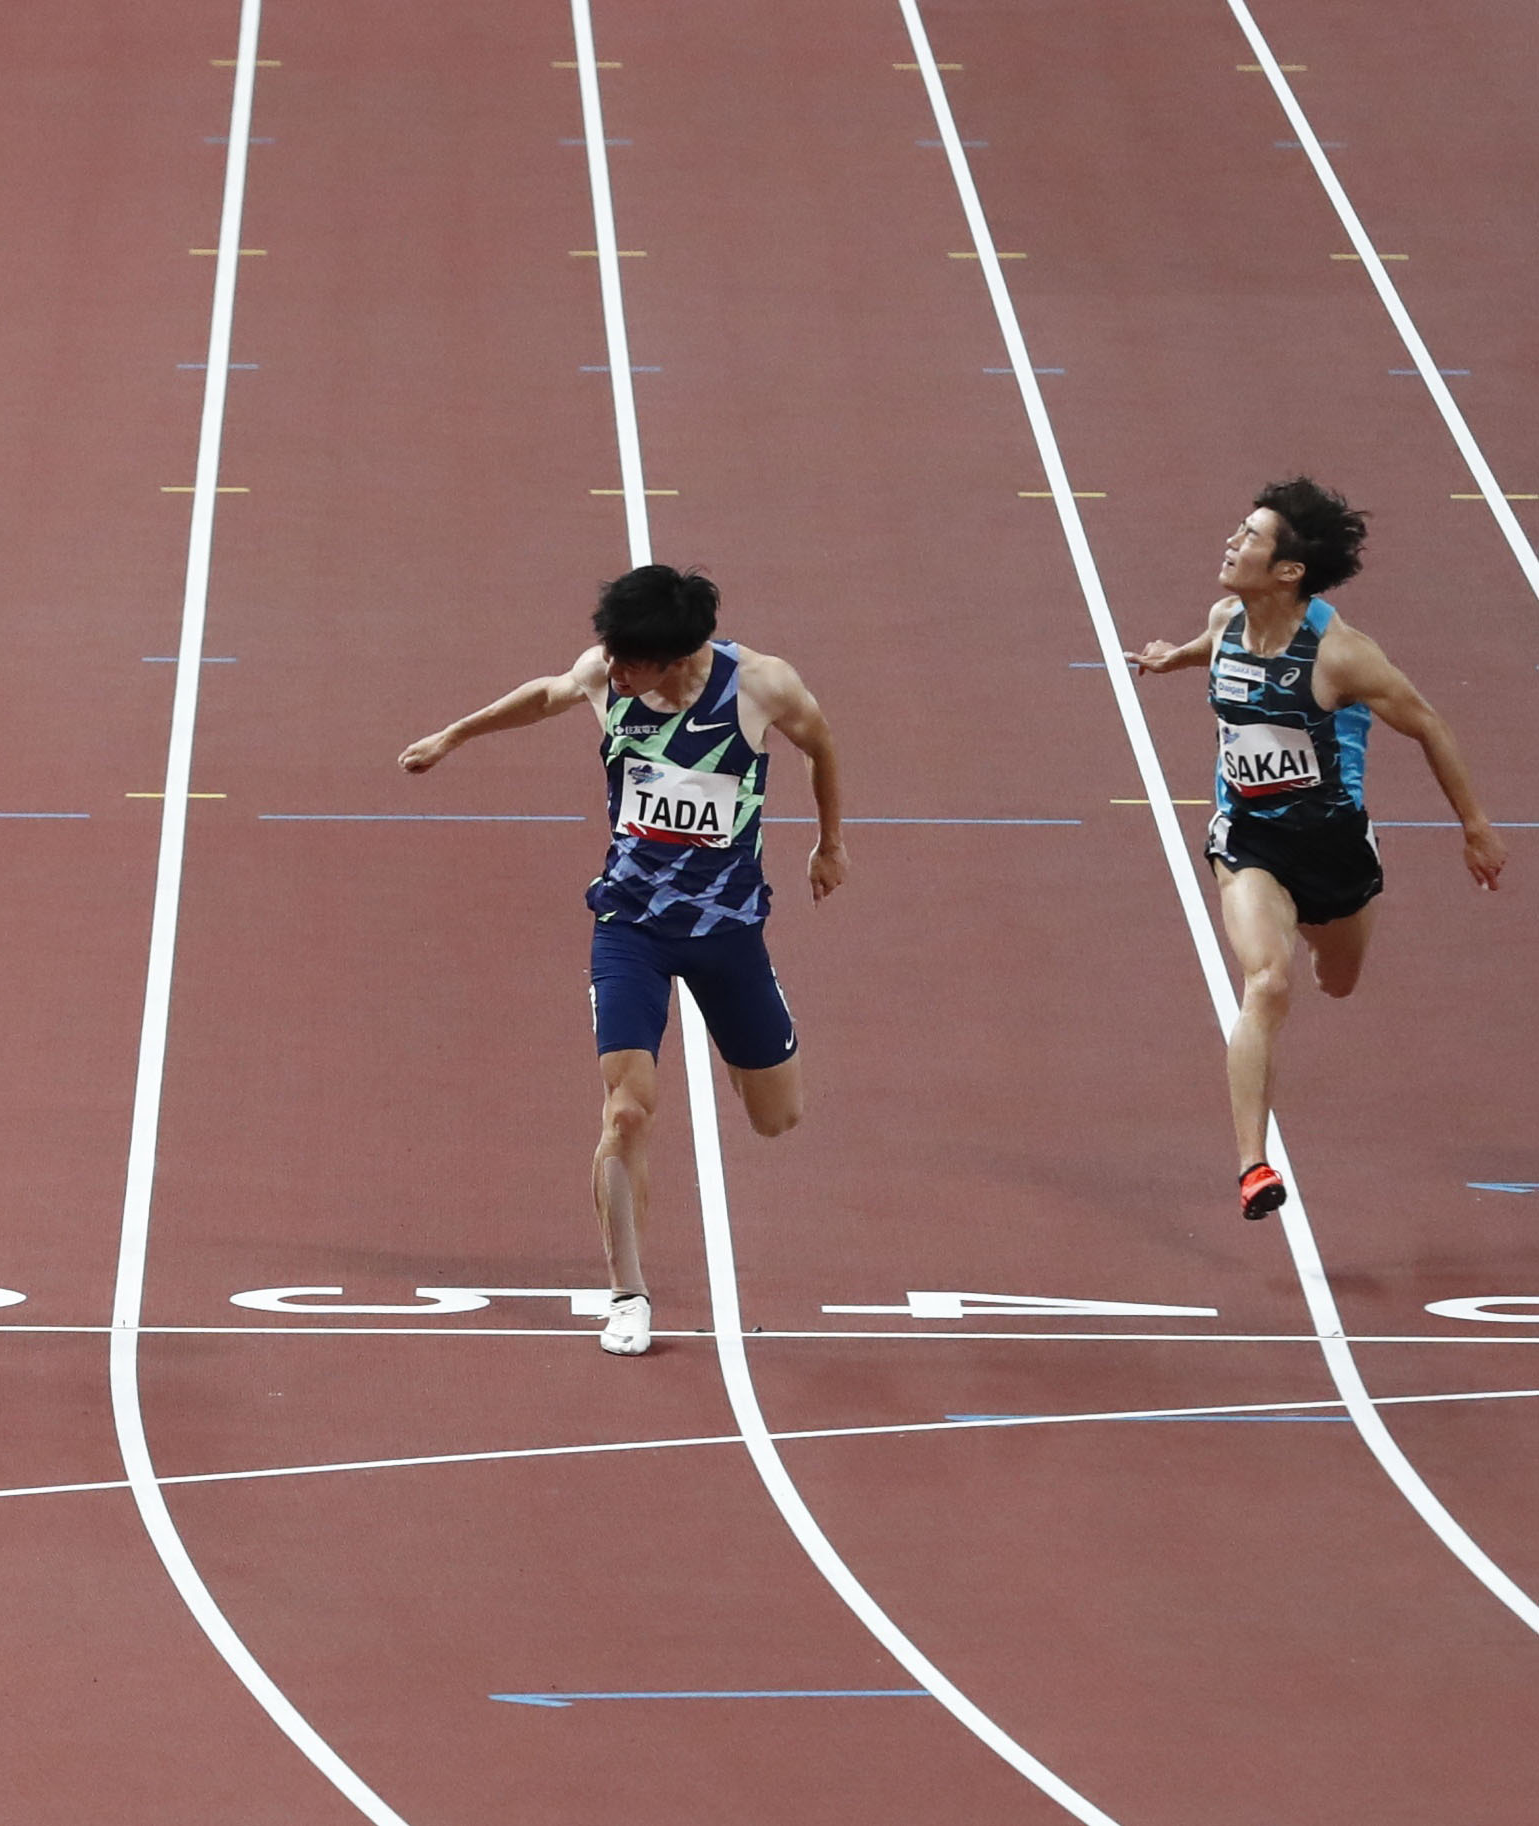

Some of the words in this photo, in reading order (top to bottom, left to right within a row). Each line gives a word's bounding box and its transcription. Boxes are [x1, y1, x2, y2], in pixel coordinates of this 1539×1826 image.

[1224, 749, 1309, 783] SAKAI
[635, 790, 719, 832] TADA
[229, 1286, 613, 1316] 5
[821, 1291, 1219, 1319] 4
